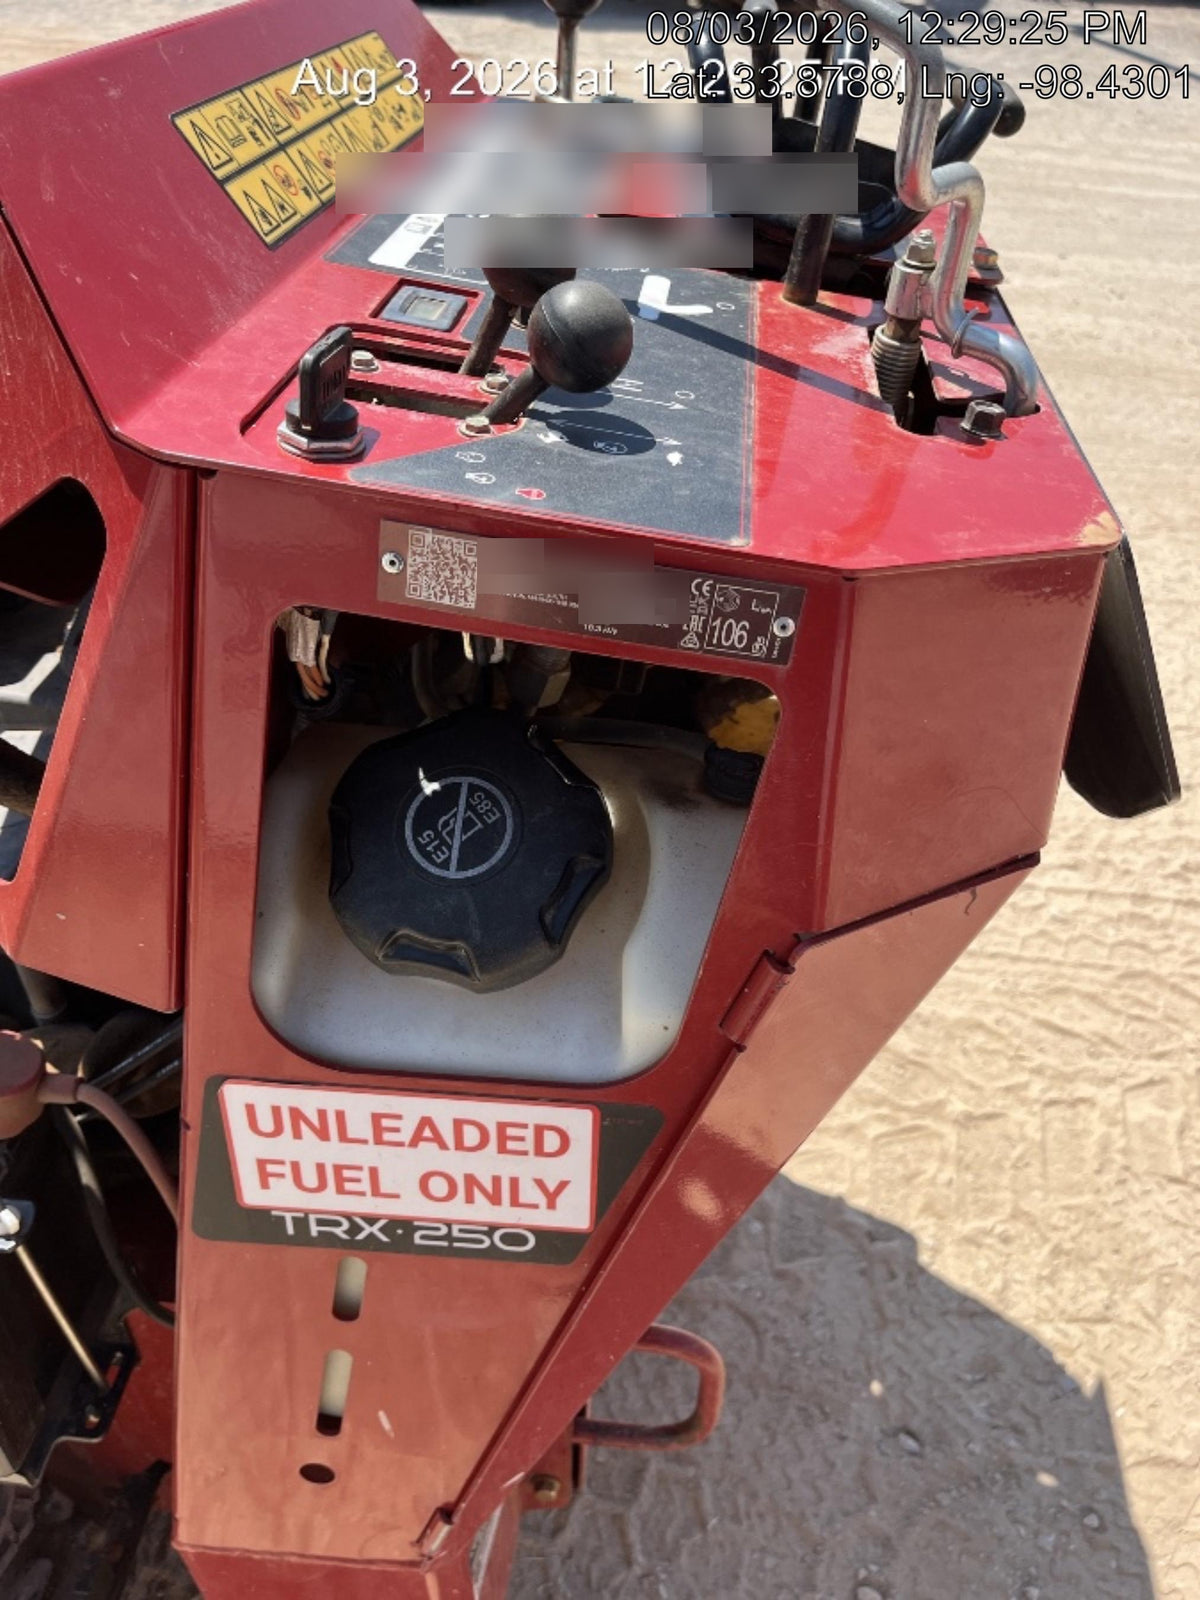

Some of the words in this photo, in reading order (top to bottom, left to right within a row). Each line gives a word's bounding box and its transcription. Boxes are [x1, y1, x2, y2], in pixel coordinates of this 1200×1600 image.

[711, 616, 750, 649] 106
[469, 791, 502, 825] E85
[417, 829, 450, 864] E15
[245, 1102, 571, 1159] UNLEADED
[256, 1157, 401, 1200] FUEL
[419, 1169, 571, 1211] ONLY
